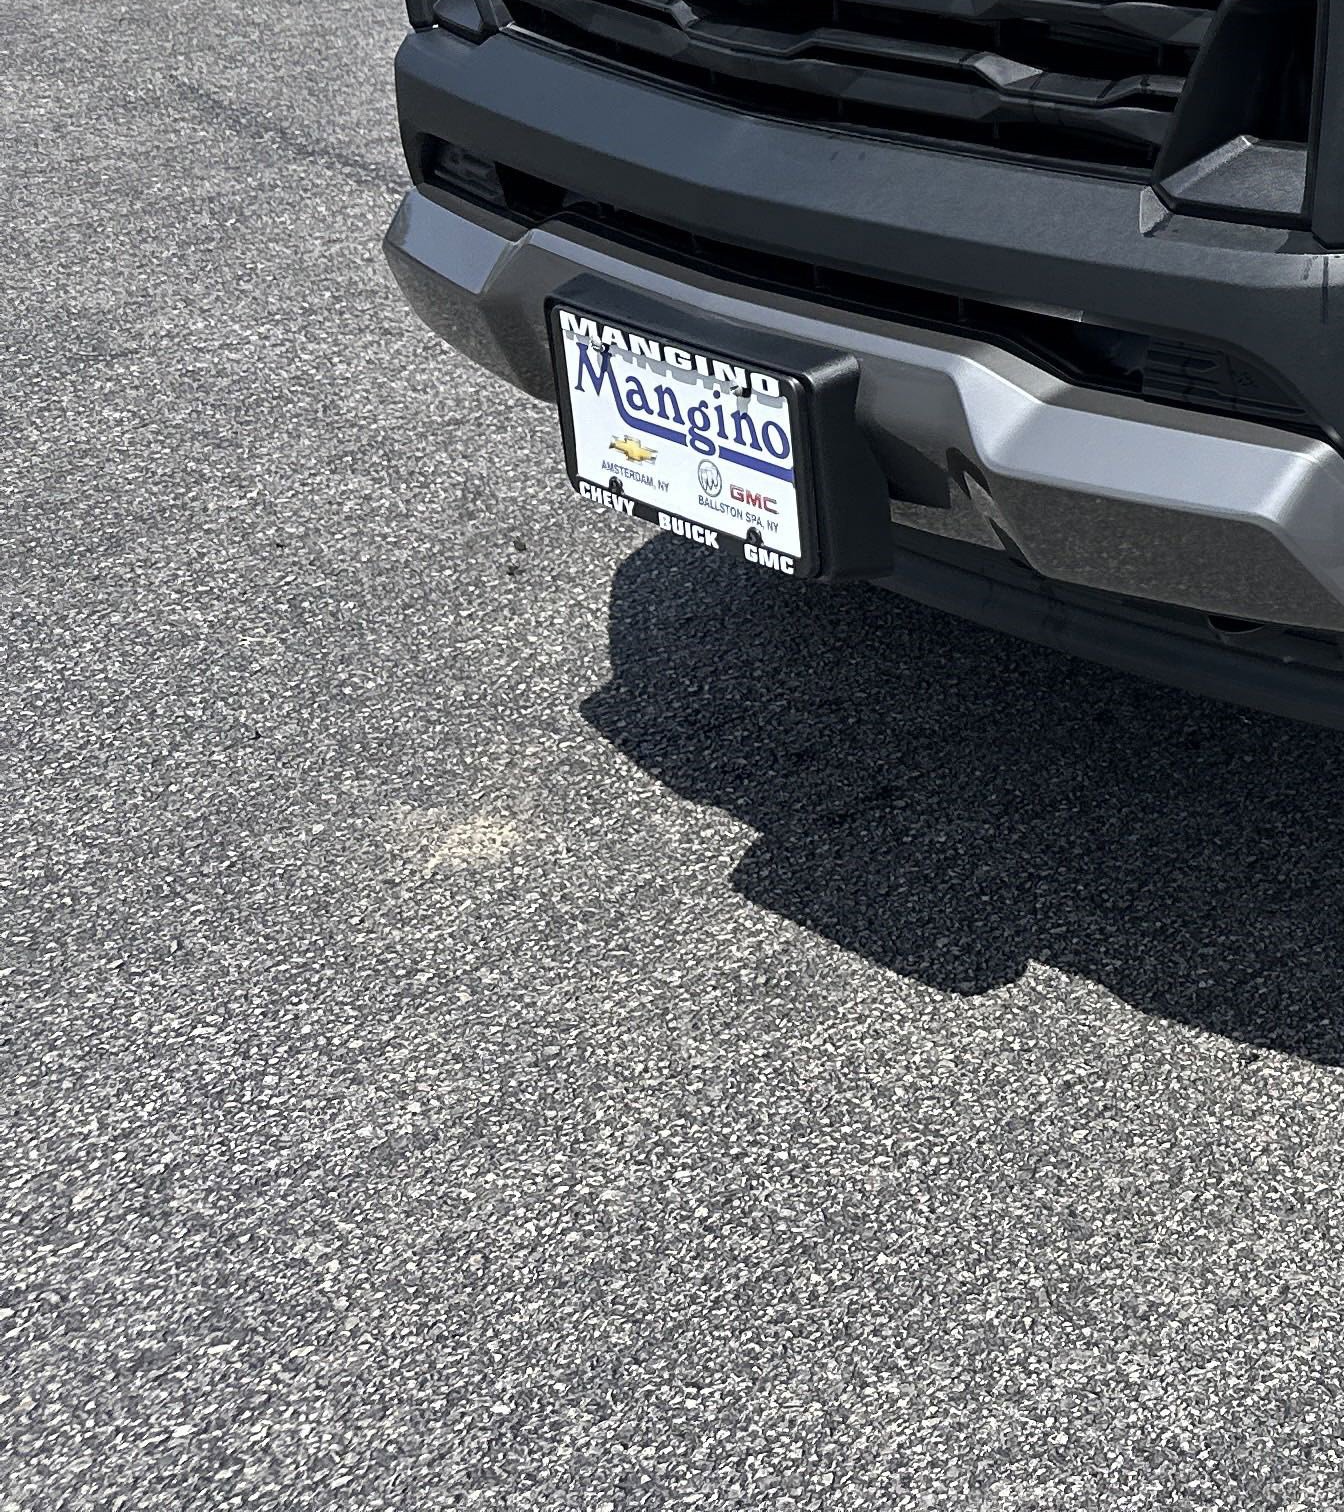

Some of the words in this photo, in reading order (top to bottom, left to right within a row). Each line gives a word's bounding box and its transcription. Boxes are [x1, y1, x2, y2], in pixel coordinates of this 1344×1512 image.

[559, 309, 780, 398] MANGINO
[574, 341, 792, 457] Mangino
[657, 479, 670, 493] NY
[698, 494, 743, 520] BALLSTON
[767, 519, 779, 534] NY
[730, 484, 779, 515] GMC
[579, 481, 635, 517] CHEVY
[658, 512, 720, 549] BUICK
[743, 544, 795, 575] GMC
